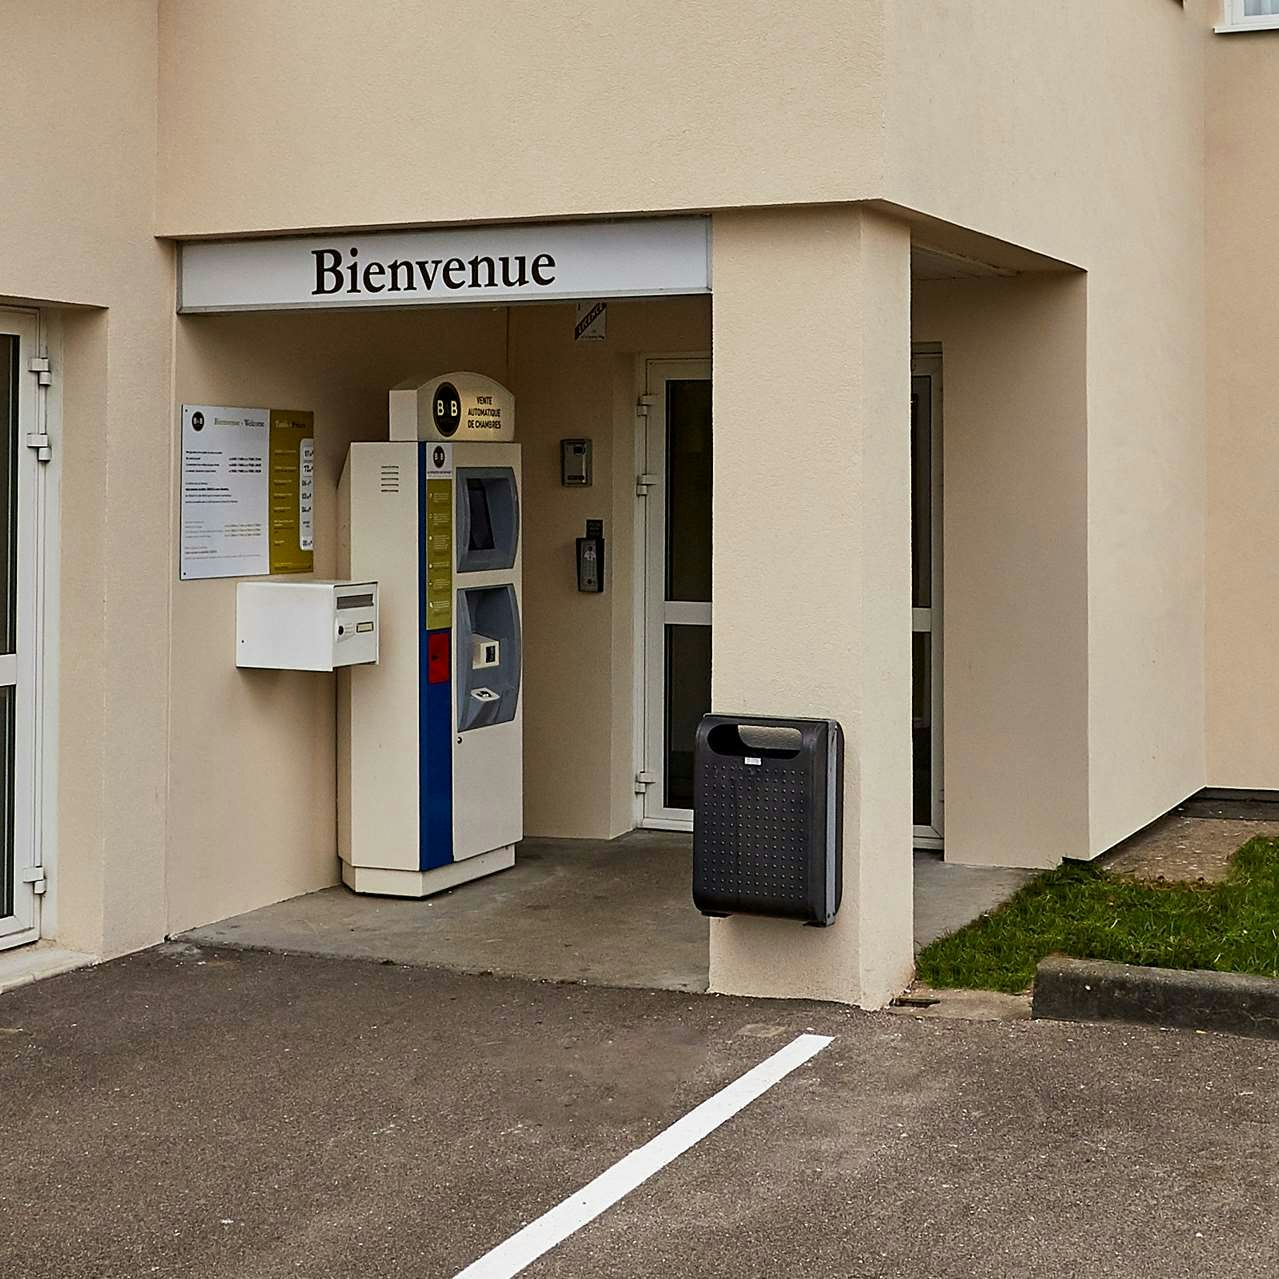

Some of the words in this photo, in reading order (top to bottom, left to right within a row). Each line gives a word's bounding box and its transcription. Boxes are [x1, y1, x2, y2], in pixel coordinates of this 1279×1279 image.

[311, 247, 556, 295] Bienvenue
[476, 396, 493, 405] VENTE
[467, 408, 501, 417] AUTOMATIQUE
[467, 420, 474, 428] DE
[475, 420, 501, 429] CHAMBRES
